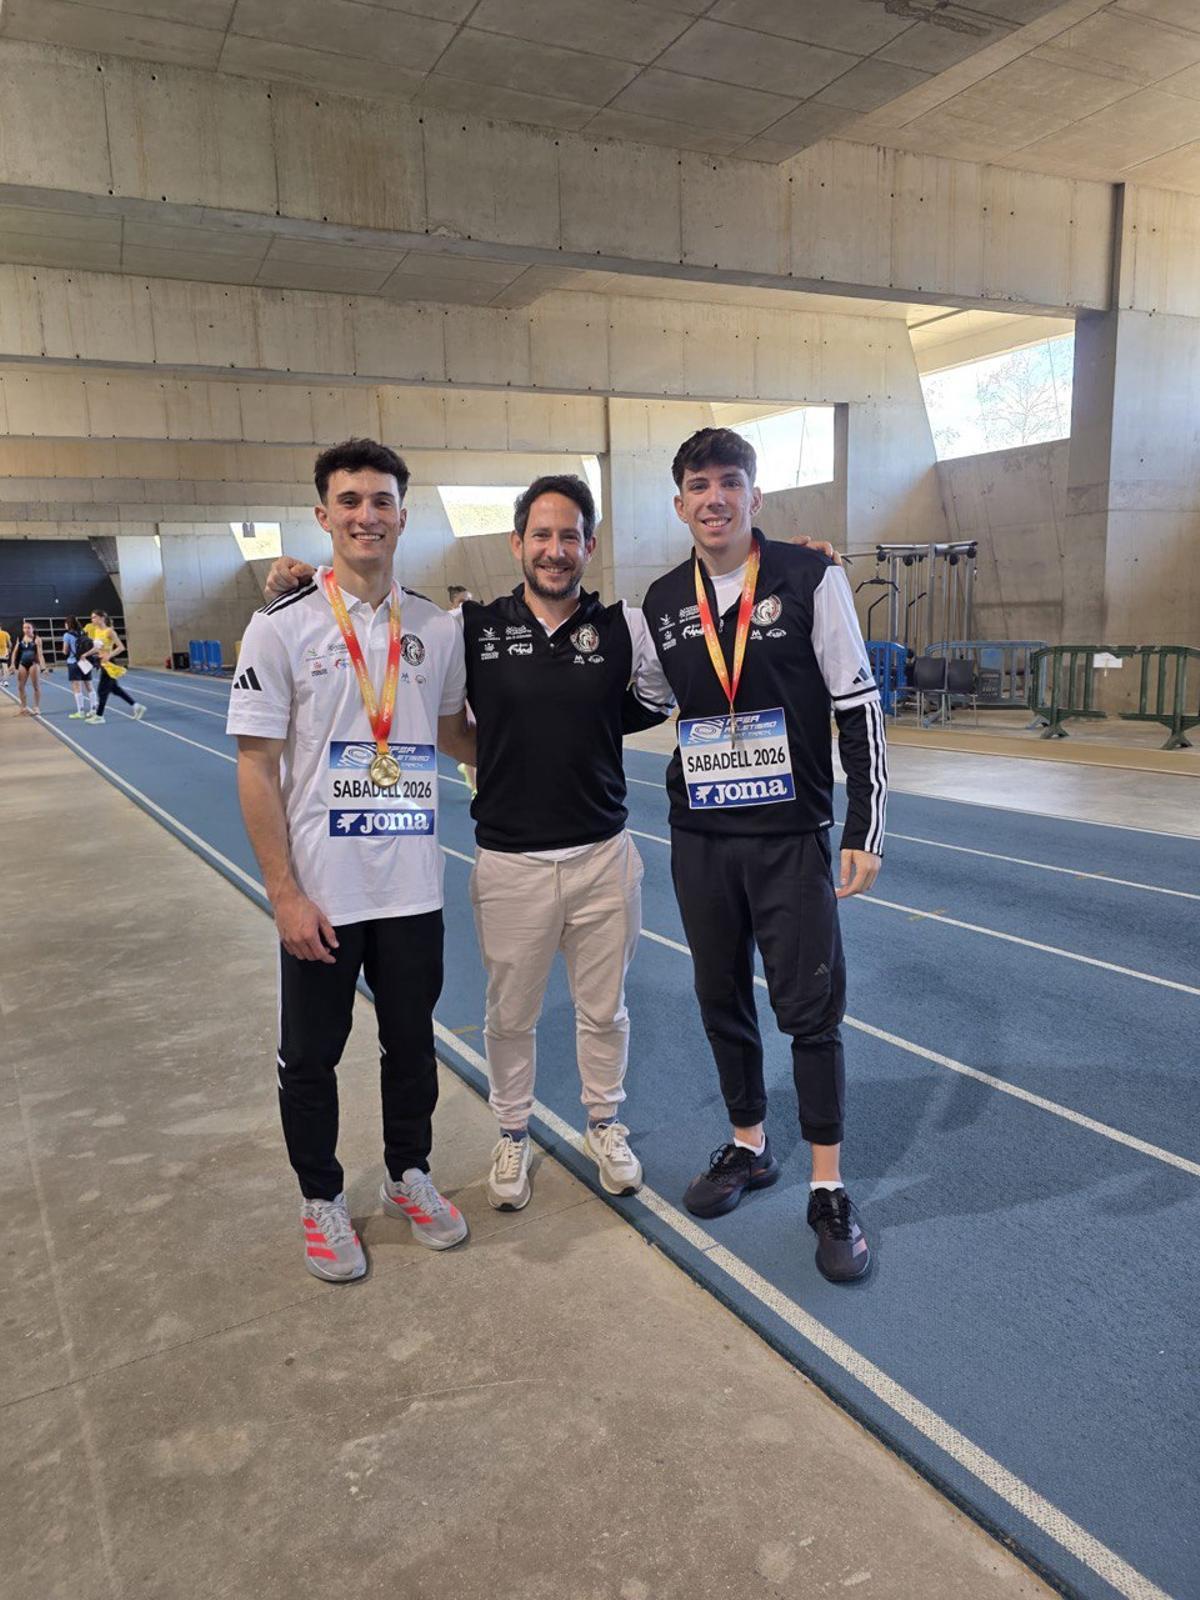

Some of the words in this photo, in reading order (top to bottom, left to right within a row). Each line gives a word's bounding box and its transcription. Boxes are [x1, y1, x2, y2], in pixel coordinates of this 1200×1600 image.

[687, 750, 752, 772] SABADELL
[754, 746, 786, 766] 2026
[333, 780, 401, 798] SABADELL
[403, 781, 432, 798] 2026
